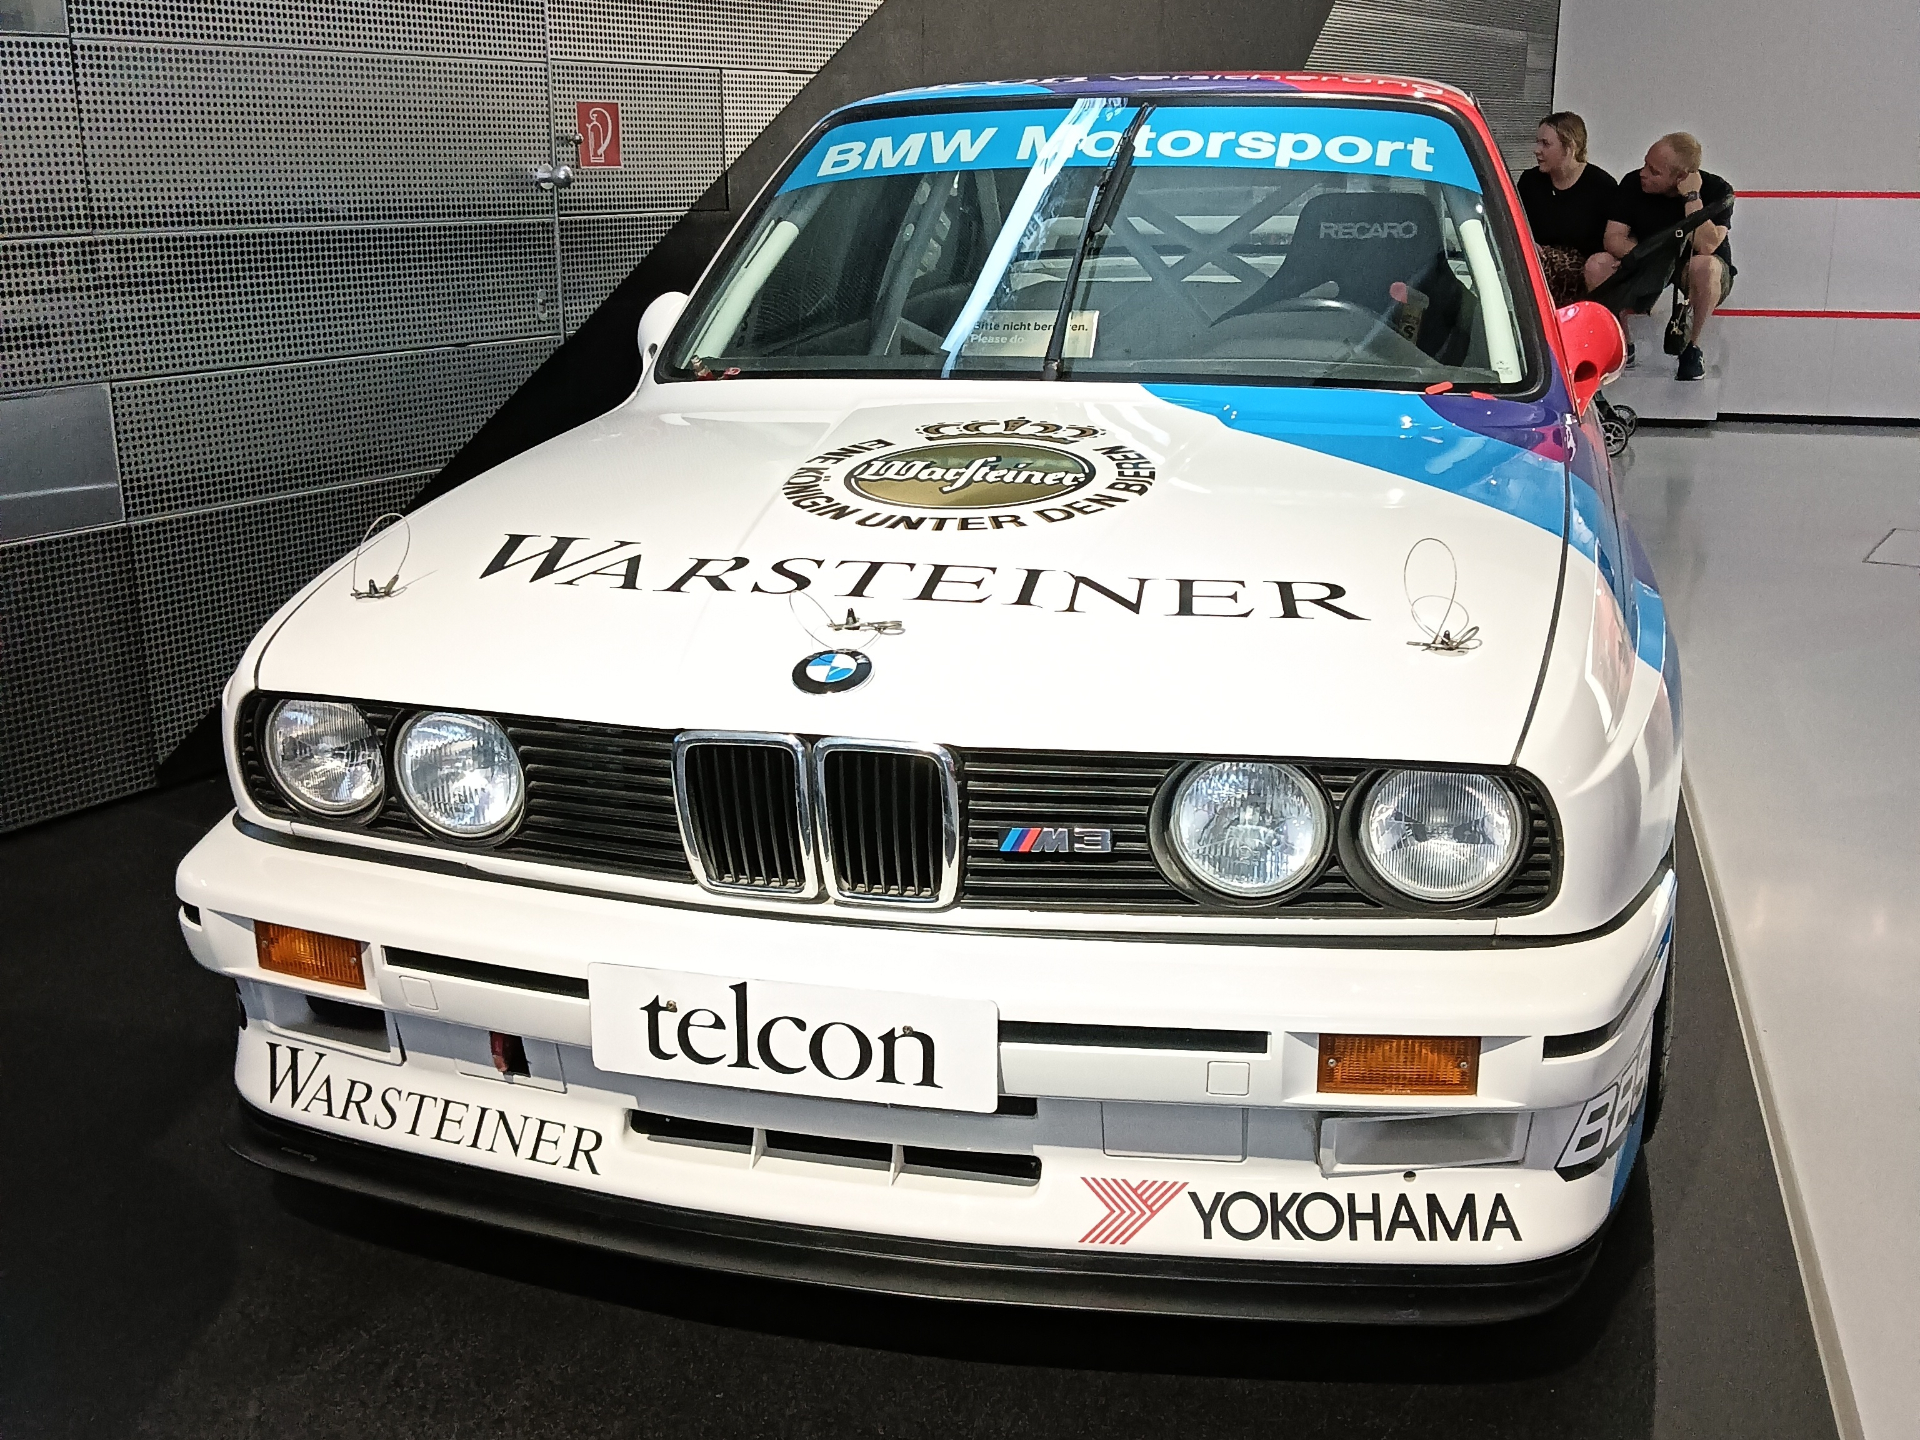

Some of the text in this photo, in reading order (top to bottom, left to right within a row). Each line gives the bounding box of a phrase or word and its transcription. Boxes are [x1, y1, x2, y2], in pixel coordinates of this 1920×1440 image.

[817, 124, 1435, 177] BMW Motorsport
[1319, 220, 1418, 240] RECARO
[970, 332, 1025, 344] Please do
[974, 321, 1088, 332] Bitte nicht beren.
[782, 438, 1156, 532] EINE KÖNIGIN UNTER DEN BIEREN
[855, 455, 1086, 494] Warsteiner
[479, 533, 1371, 622] WARSTEINER
[1030, 827, 1112, 853] M3
[639, 981, 944, 1090] telcon
[266, 1041, 605, 1176] WARSTEINER
[1553, 1032, 1651, 1182] BBS
[1187, 1191, 1524, 1242] YOKOHAMA
